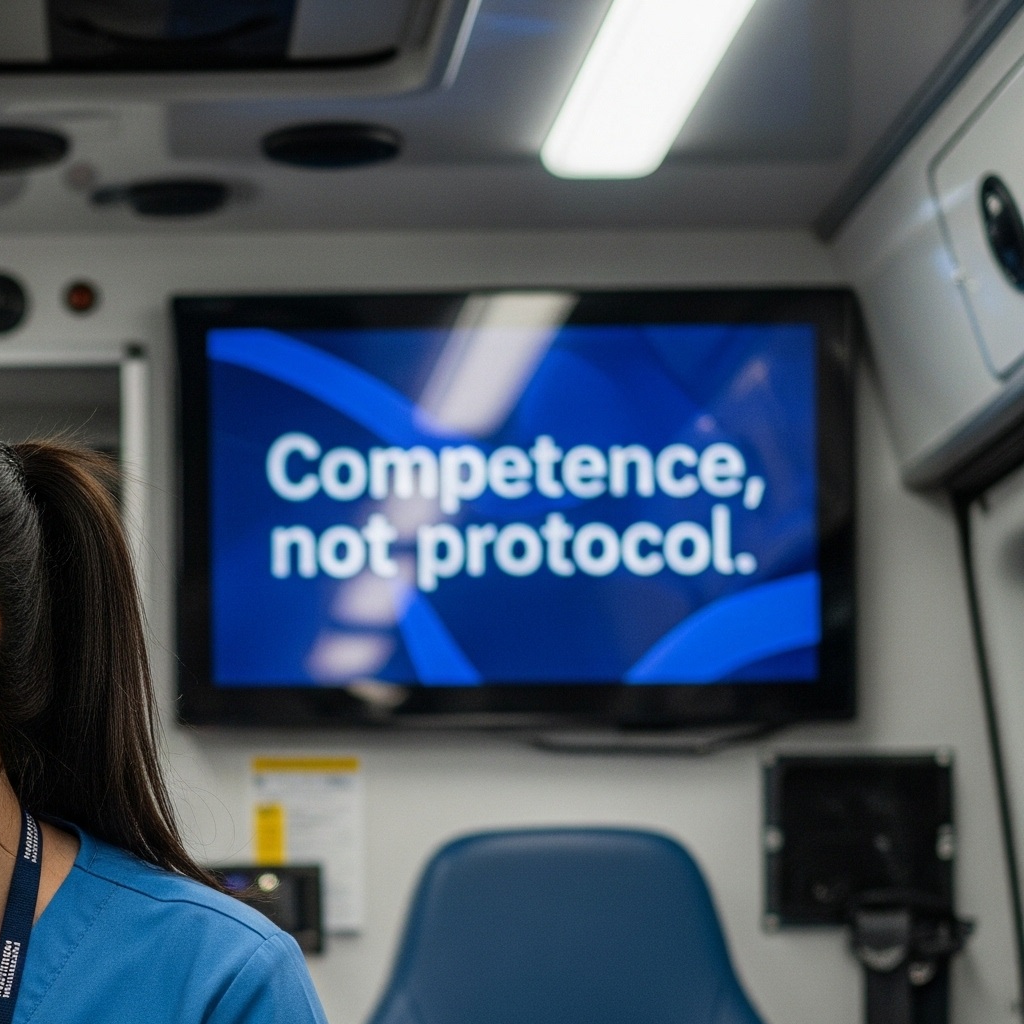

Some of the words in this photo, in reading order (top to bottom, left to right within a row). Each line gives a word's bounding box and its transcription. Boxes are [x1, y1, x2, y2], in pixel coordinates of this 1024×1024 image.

[266, 433, 765, 514] Competence,
[271, 515, 397, 578] not
[417, 505, 757, 591] protocol.
